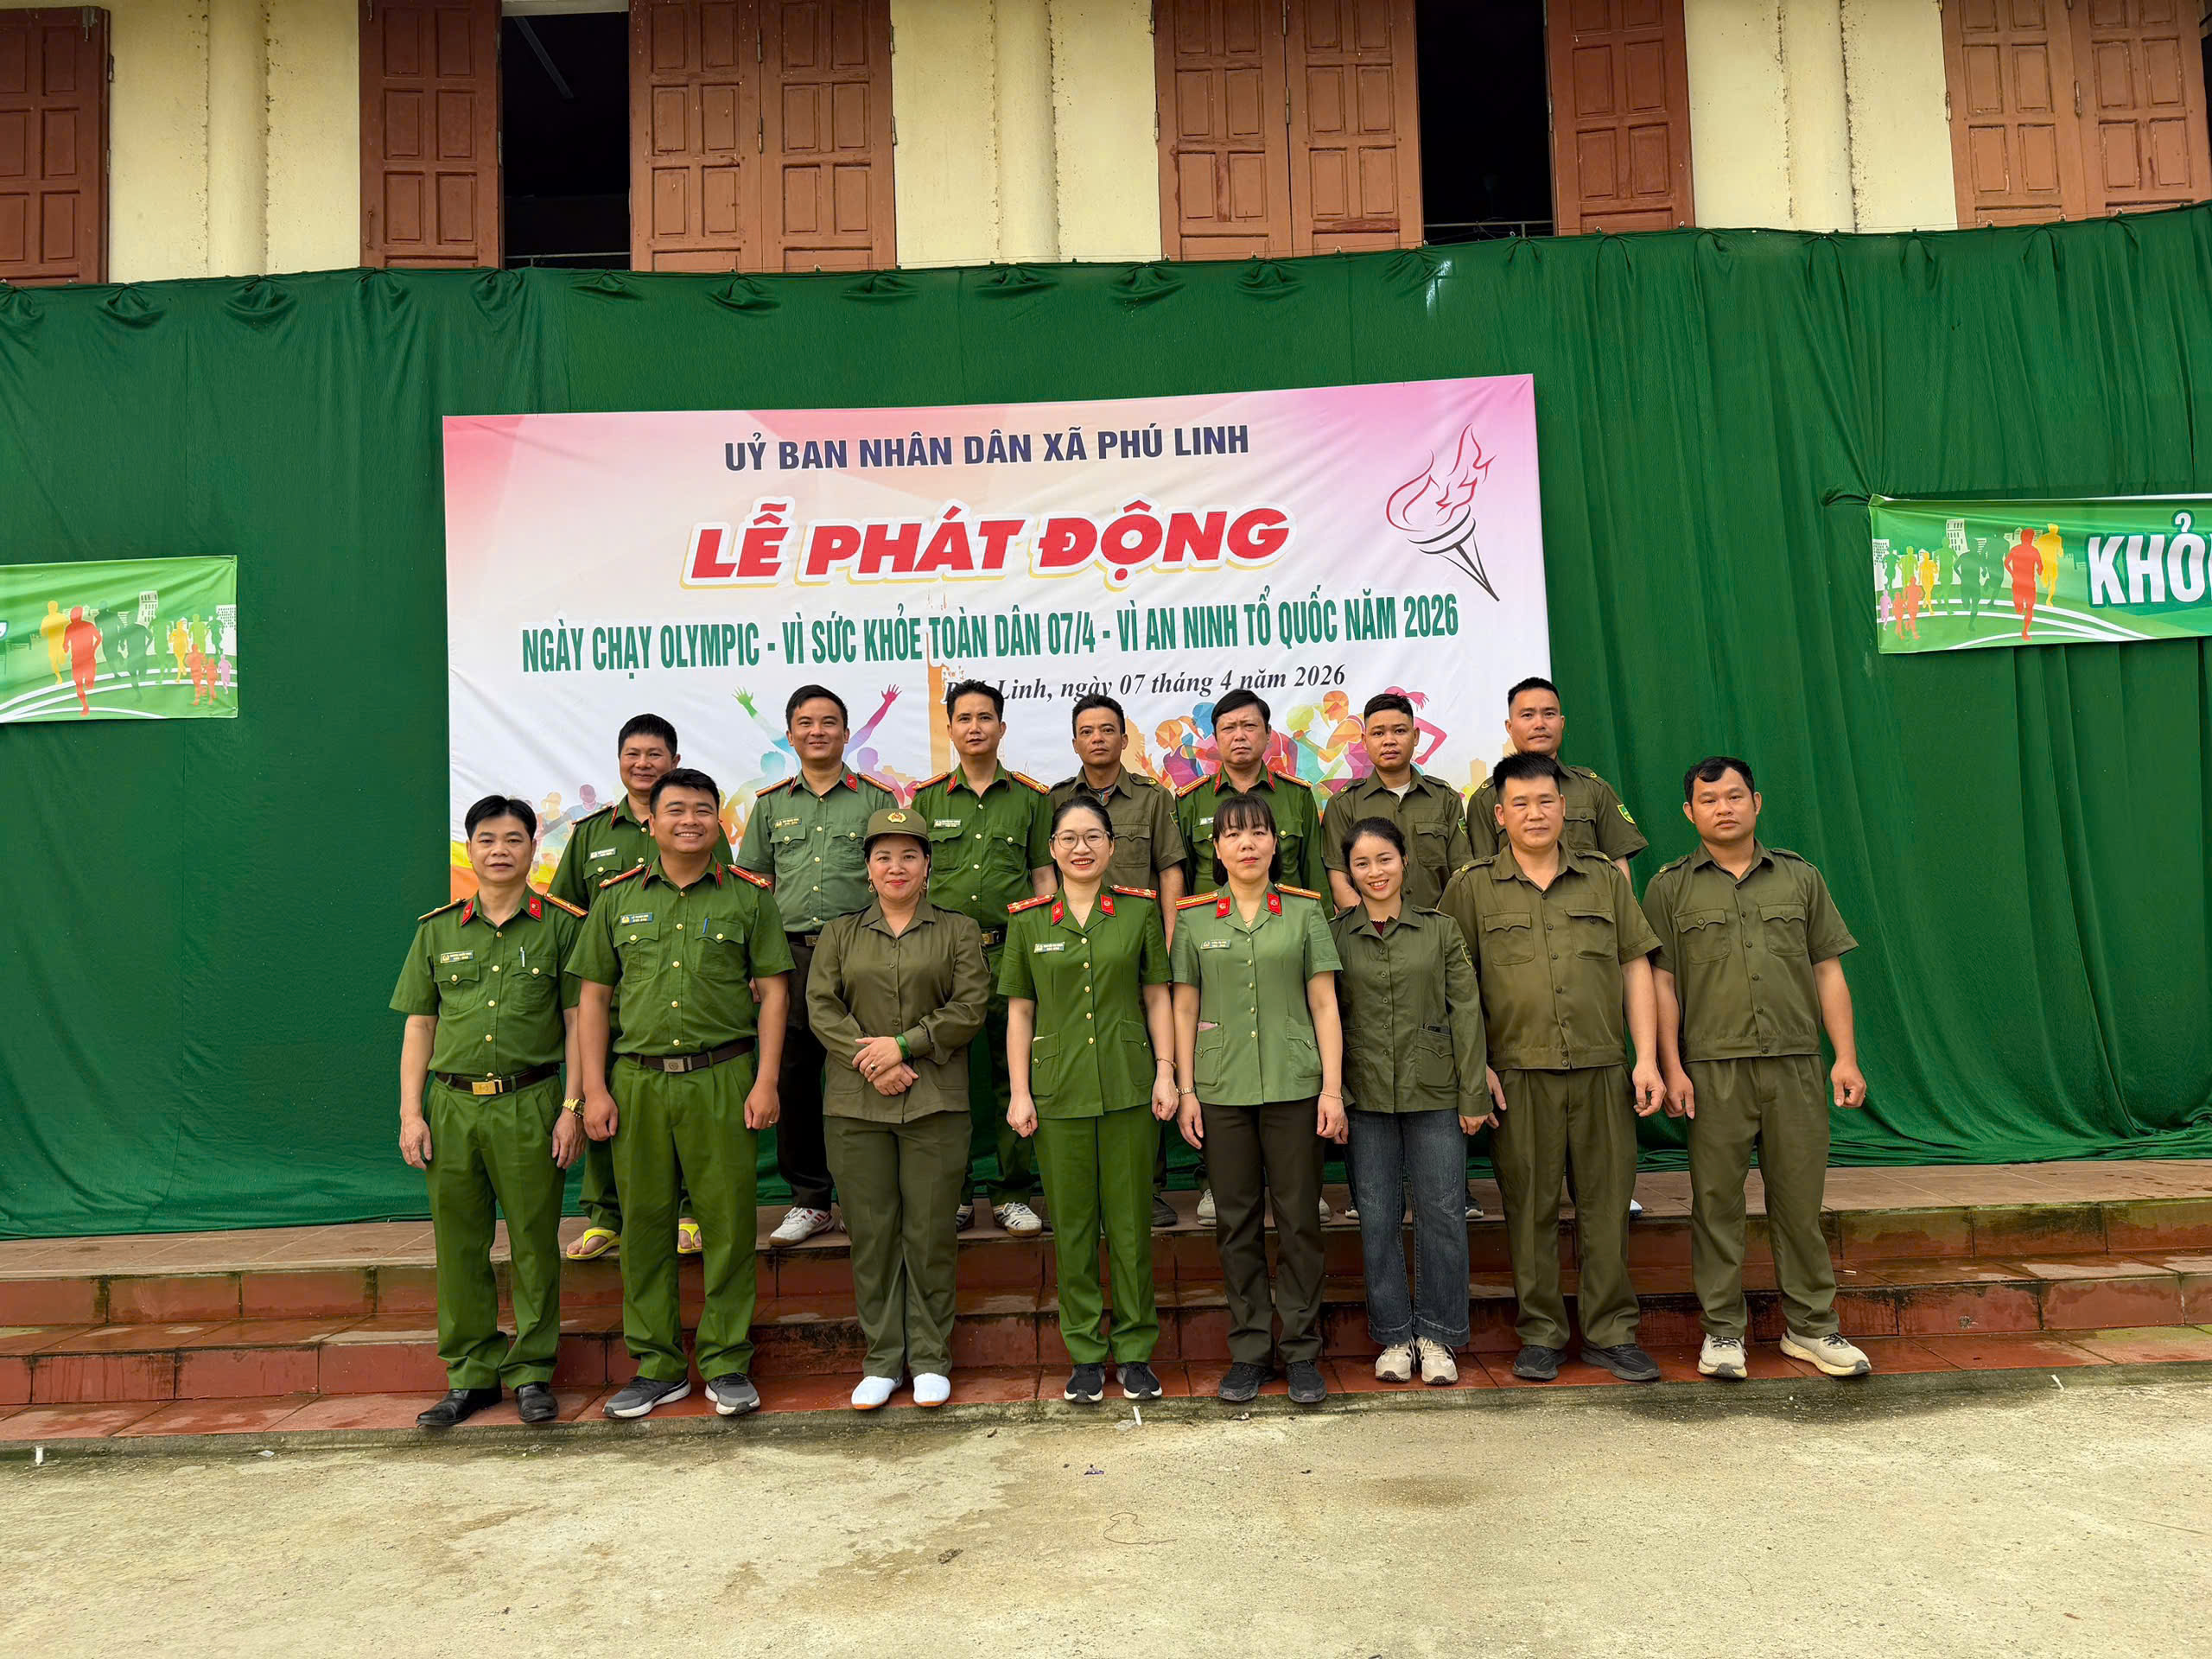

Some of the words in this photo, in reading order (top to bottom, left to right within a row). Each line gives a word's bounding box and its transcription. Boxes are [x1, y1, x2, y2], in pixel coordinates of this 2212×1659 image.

[726, 432, 766, 470] UỶ
[779, 441, 847, 469] BAN
[860, 432, 951, 467] NHÂN
[964, 429, 1031, 464] DÂN
[1043, 427, 1086, 461] XÃ
[1098, 423, 1162, 459] PHÚ
[1175, 425, 1248, 455] LINH
[692, 504, 788, 578] LỄ
[806, 506, 1025, 575] PHÁT
[1039, 499, 1288, 581] ĐỘNG
[2088, 513, 2212, 604] KHỎ
[523, 620, 584, 672] NGÀY
[593, 626, 651, 678] CHẠY
[661, 624, 759, 668] OLYMPIC
[783, 612, 804, 664] VÌ
[812, 610, 856, 664] SỨC
[864, 603, 923, 662] KHỎE
[928, 607, 987, 658] TOÀN
[995, 606, 1040, 656] DÂN
[1048, 612, 1095, 654] 07/4
[1117, 600, 1138, 652] VÌ
[1147, 608, 1176, 650] AN
[1184, 606, 1237, 648] NINH
[1243, 584, 1272, 646] TỔ
[1279, 584, 1337, 649] QUỐC
[1344, 589, 1397, 641] NĂM
[1404, 594, 1458, 637] 2026
[1120, 674, 1146, 695] 07
[1152, 673, 1213, 696] tháng
[1221, 671, 1232, 690] 4
[1240, 668, 1287, 690] năm
[1294, 664, 1344, 686] 2026
